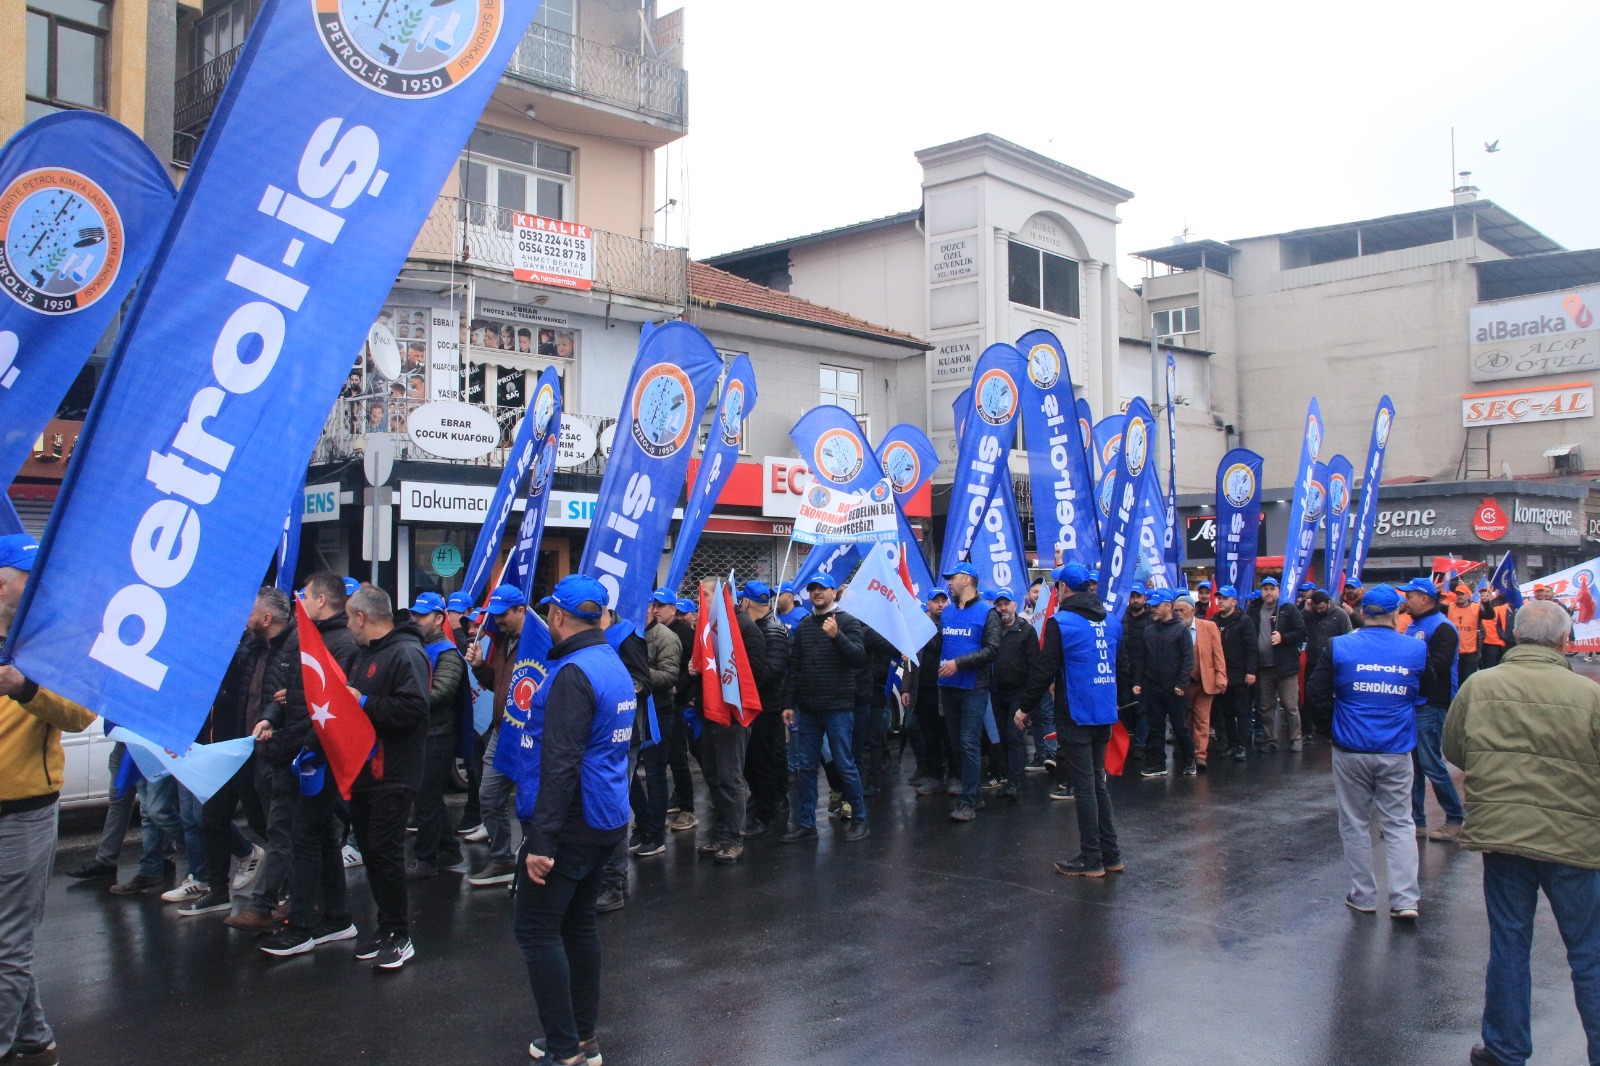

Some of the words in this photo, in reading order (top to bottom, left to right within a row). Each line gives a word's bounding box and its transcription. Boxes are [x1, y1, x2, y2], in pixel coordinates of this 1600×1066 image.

[326, 21, 389, 89] PETROL-İŞ
[401, 76, 443, 92] 1950
[23, 175, 57, 190] PETROL
[517, 214, 587, 237] KİRALIK
[520, 229, 543, 243] 0532
[545, 234, 561, 245] 224
[563, 237, 573, 248] 41
[574, 239, 585, 250] 55
[519, 241, 542, 255] 0554
[544, 245, 560, 257] 522
[562, 249, 573, 259] 87
[575, 251, 586, 261] 78
[940, 241, 966, 253] DÜZCE
[943, 250, 963, 260] ÖZEL
[522, 254, 551, 264] AHMET
[552, 258, 584, 270] BEKTAŞ
[934, 257, 973, 271] GÜVENLİK
[43, 299, 72, 310] 1950
[512, 306, 538, 315] EBRAR
[482, 307, 505, 316] PROTEZ
[518, 312, 542, 320] TASARIM
[543, 315, 567, 325] MERKEZİ
[1476, 315, 1566, 342] alBaraka
[939, 343, 971, 355] AÇELYA
[938, 355, 972, 367] KUAFÖR
[1515, 353, 1594, 372] OTEL
[505, 390, 520, 400] SAÇ
[90, 116, 389, 691] petrol-iş
[1466, 393, 1588, 422] SEÇ-AL
[441, 418, 471, 428] EBRAR
[416, 429, 449, 441] ÇOCUK
[450, 431, 494, 444] KUAFÖRÜ
[565, 433, 582, 442] SAÇ
[658, 446, 674, 455] 1950
[881, 503, 895, 515] BİZ
[1514, 499, 1572, 532] komagene
[1391, 529, 1413, 538] etsiz
[1415, 528, 1429, 539] çiğ
[1431, 527, 1457, 536] köfte
[1096, 640, 1108, 648] KA
[1097, 662, 1112, 674] OL
[1356, 663, 1409, 676] petrol-iş
[1353, 681, 1407, 696] SENDİKASI
